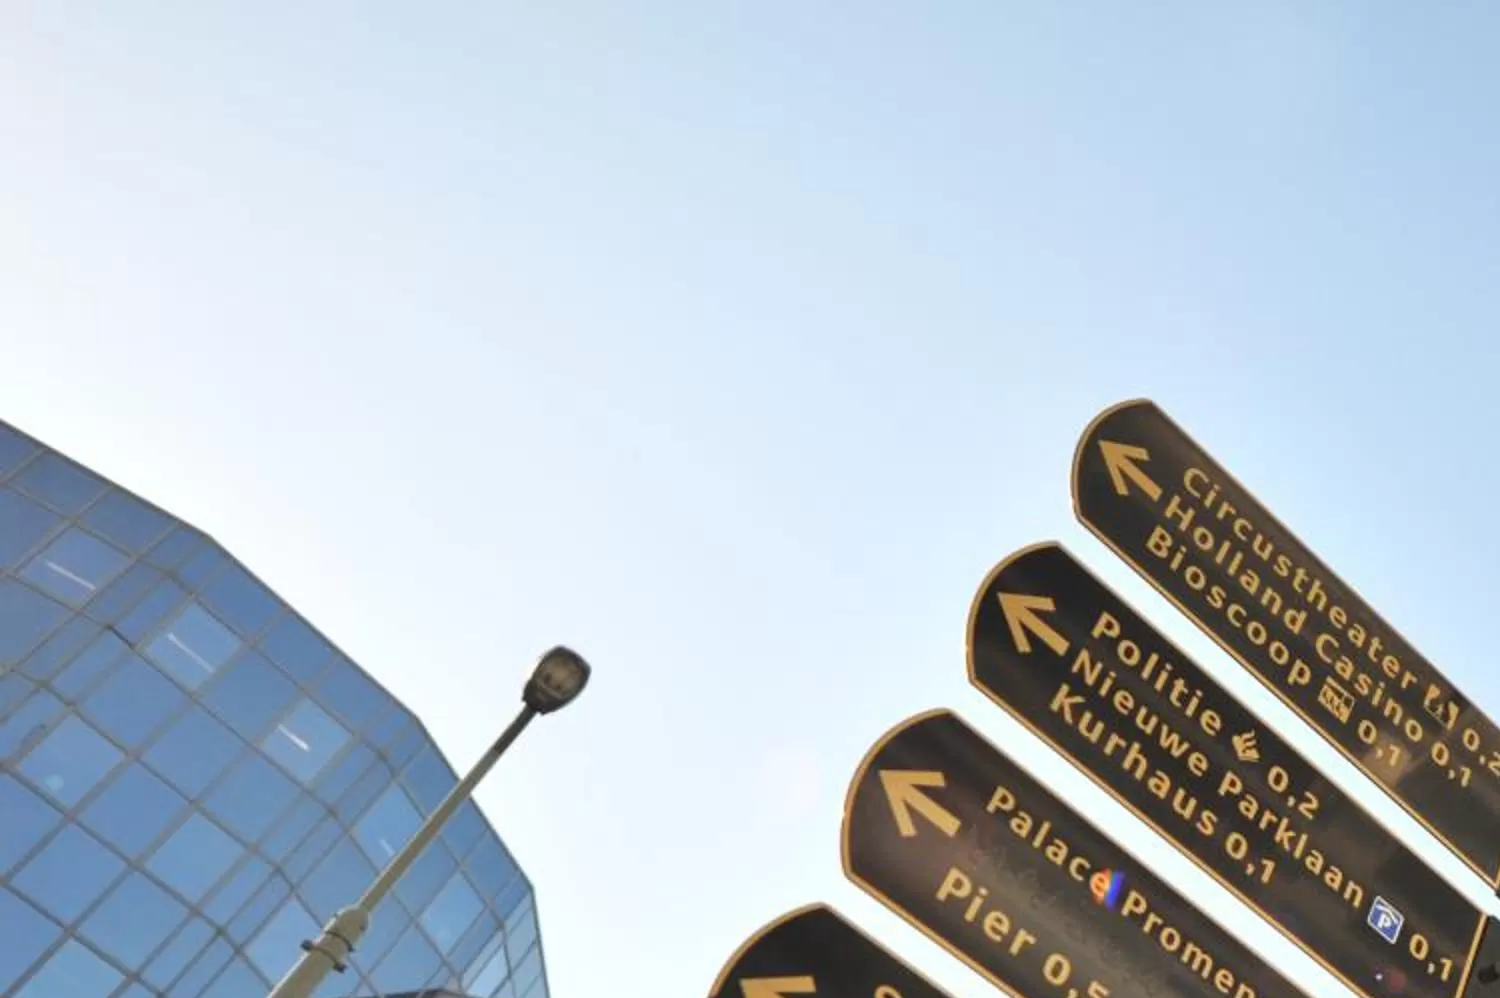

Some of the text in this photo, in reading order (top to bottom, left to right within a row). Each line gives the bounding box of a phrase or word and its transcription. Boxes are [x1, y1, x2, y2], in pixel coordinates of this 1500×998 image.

[1146, 525, 1400, 766] Bioscoop 0,1
[1165, 496, 1472, 788] Holland Casino 0,1
[1183, 468, 1417, 690] Circustheater
[1050, 684, 1276, 885] Kurhaus 0,1
[1071, 649, 1209, 776] Nieuwe
[1219, 771, 1363, 908] Parklaan
[1408, 933, 1454, 982] 0,1
[1092, 612, 1320, 821] Politie 0,2
[936, 867, 1036, 957] Pier
[985, 785, 1110, 899] Palace
